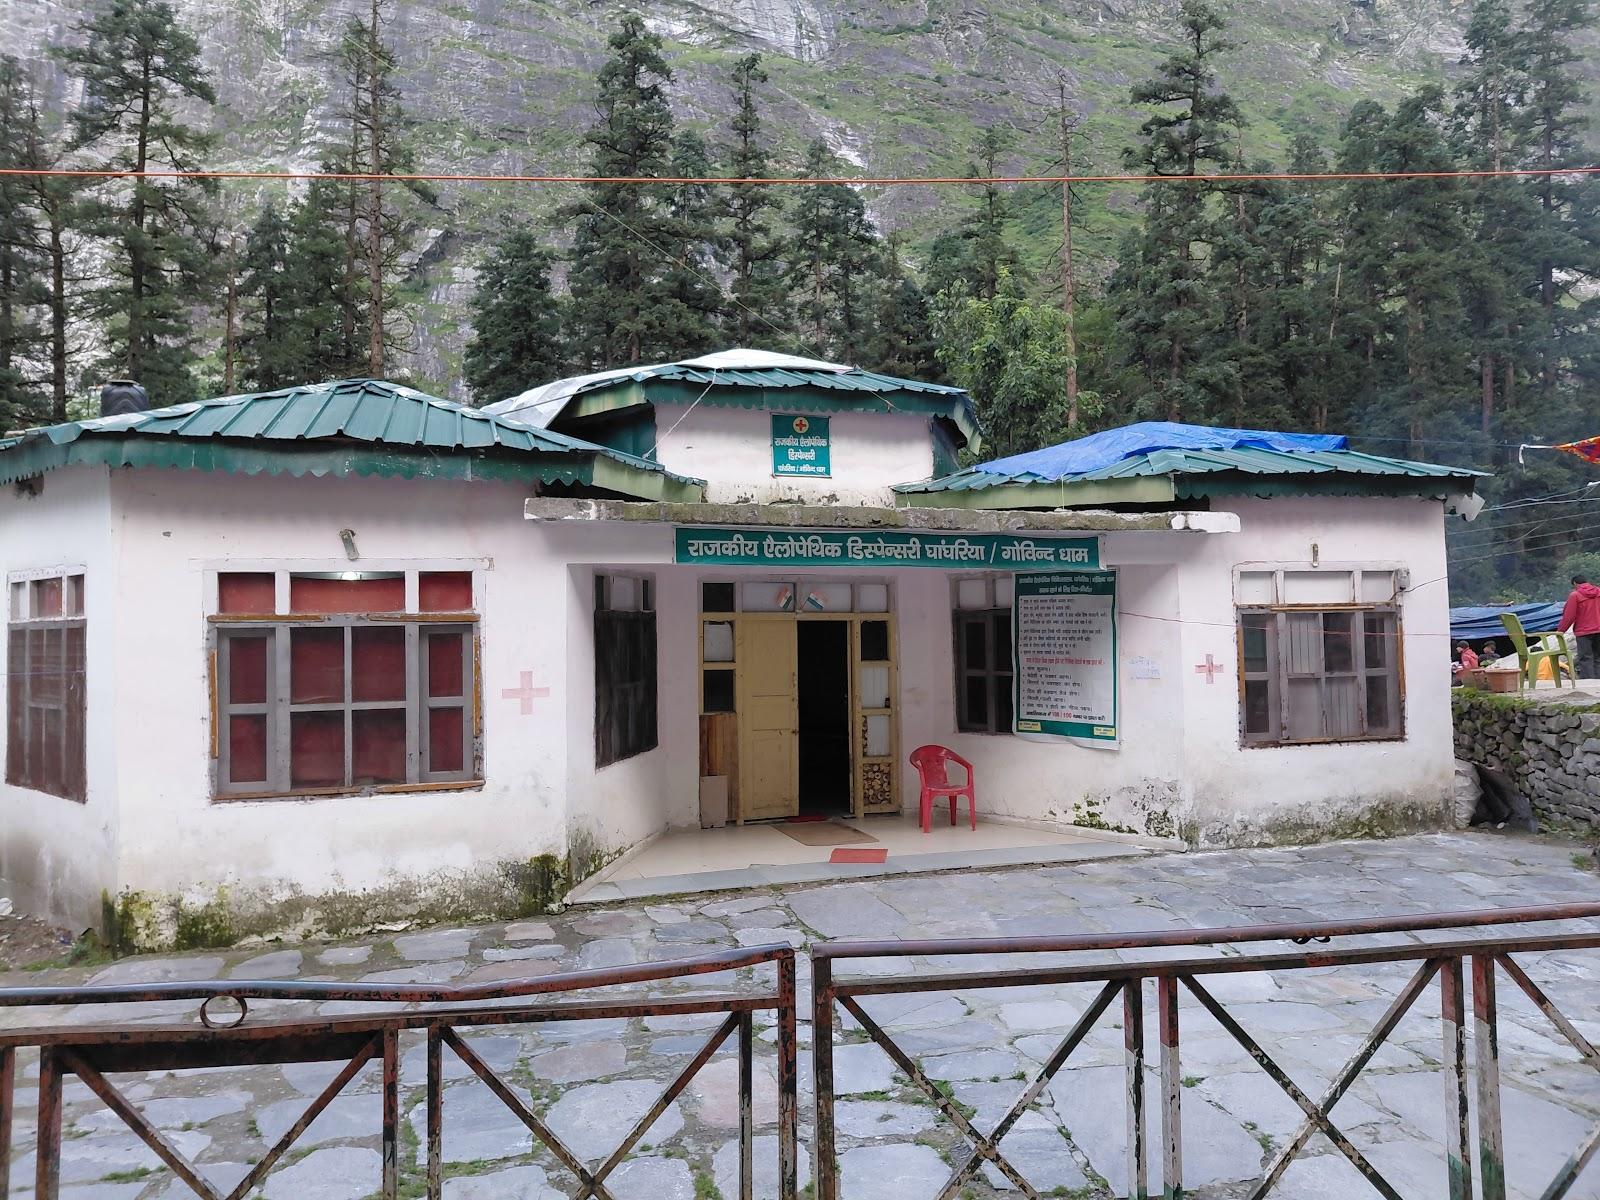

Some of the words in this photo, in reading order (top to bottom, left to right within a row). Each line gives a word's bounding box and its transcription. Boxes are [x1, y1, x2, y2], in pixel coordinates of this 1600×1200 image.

[688, 534, 759, 557] राजकीय
[847, 536, 921, 560] डिस्पेन्सरी
[925, 538, 985, 561] घांघरिया
[989, 542, 997, 564] /
[1000, 541, 1055, 562] गोविन्द
[1058, 546, 1089, 563] धाम
